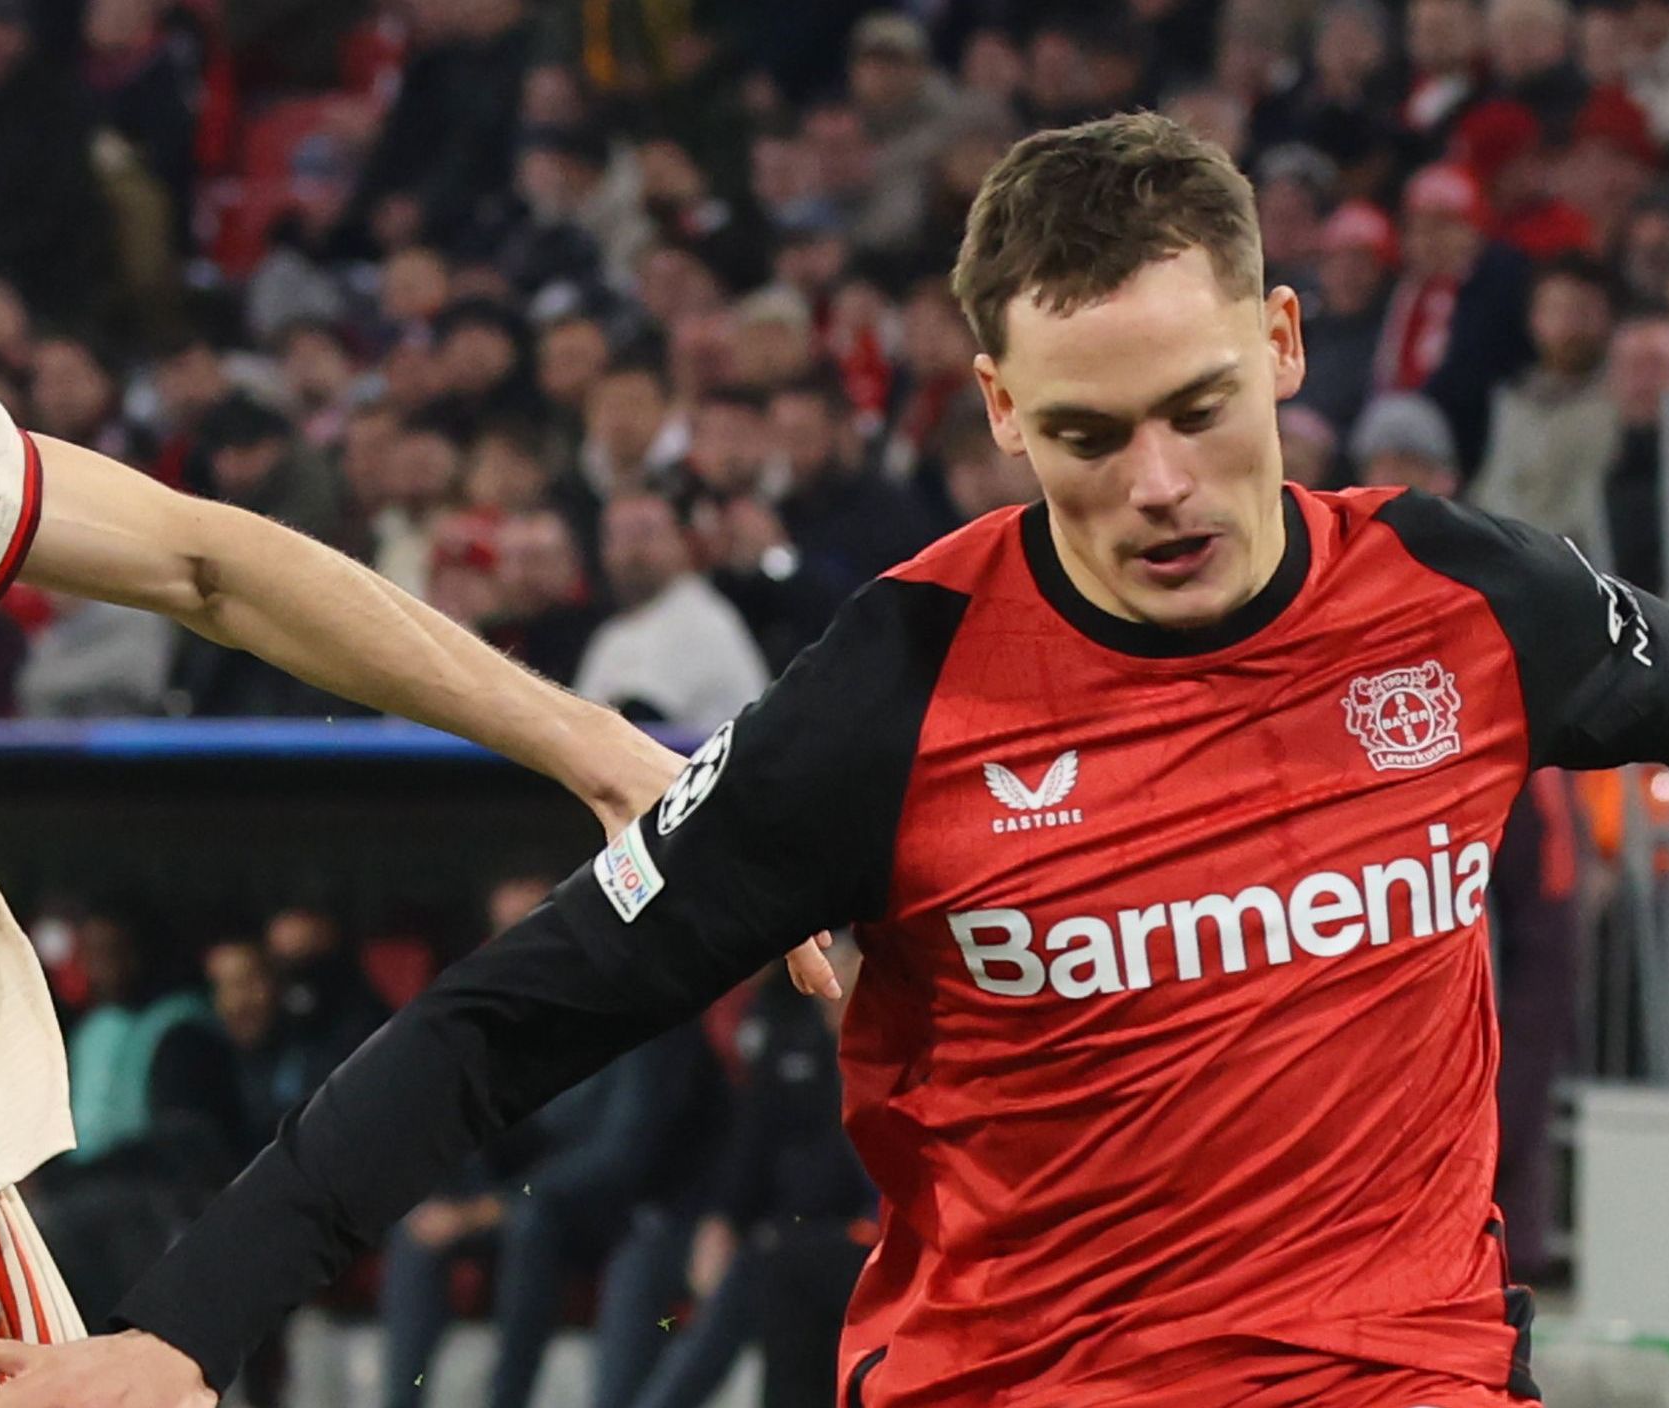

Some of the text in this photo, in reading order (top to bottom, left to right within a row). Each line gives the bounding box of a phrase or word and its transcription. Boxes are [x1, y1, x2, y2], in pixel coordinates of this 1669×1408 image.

[1381, 709, 1430, 731] BAYER
[1376, 740, 1454, 765] Leverkusen
[992, 809, 1083, 833] CASTORE
[947, 823, 1491, 999] Barmenia
